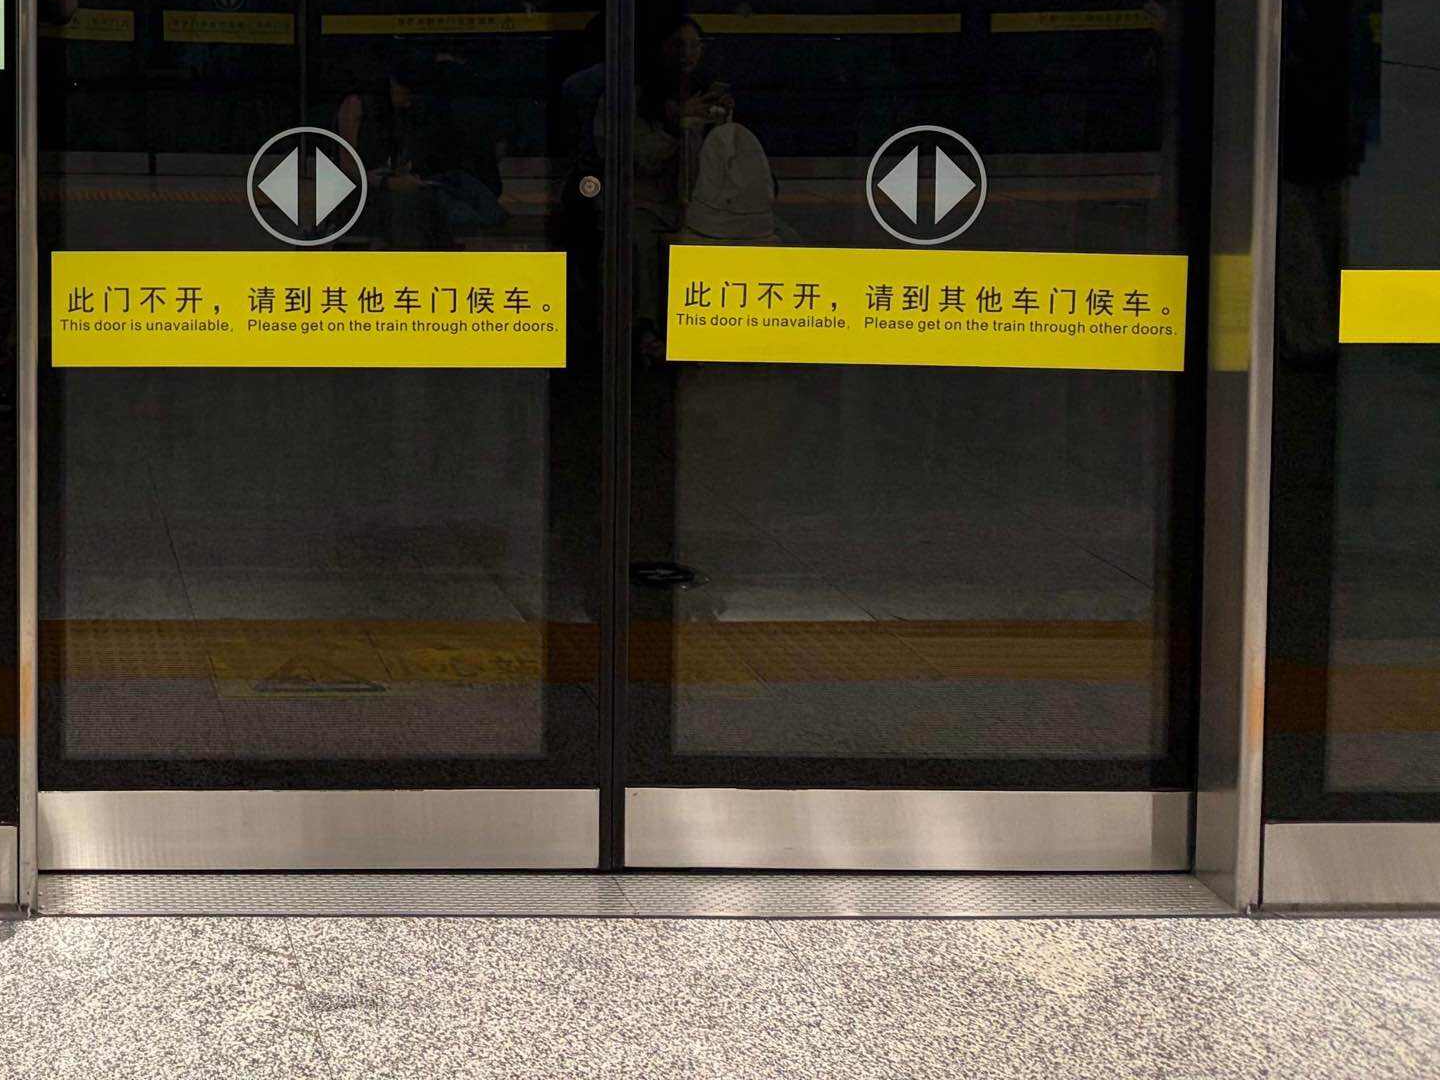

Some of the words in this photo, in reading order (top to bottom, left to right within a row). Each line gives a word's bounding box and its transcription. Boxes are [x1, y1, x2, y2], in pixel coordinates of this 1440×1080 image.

[68, 286, 550, 314] 此门不开，请到其他车门候车。
[684, 281, 1171, 316] 此门不开，请到其他车门候车。
[60, 319, 90, 331] This
[95, 320, 126, 331] door
[131, 320, 141, 330] is
[248, 320, 296, 331] Please
[301, 321, 323, 334] get
[328, 322, 344, 331] on
[350, 321, 371, 331] the
[376, 320, 407, 331] train
[413, 320, 467, 334] through
[472, 321, 509, 331] other
[513, 321, 557, 331] doors.
[676, 314, 706, 325] This
[711, 315, 743, 326] door
[747, 318, 758, 326] is
[865, 317, 913, 329] Please
[918, 320, 940, 332] get
[945, 321, 961, 330] on
[967, 320, 988, 331] the
[994, 320, 1024, 331] train
[1030, 321, 1085, 336] through
[1090, 323, 1128, 334] other
[1132, 323, 1176, 335] doors.
